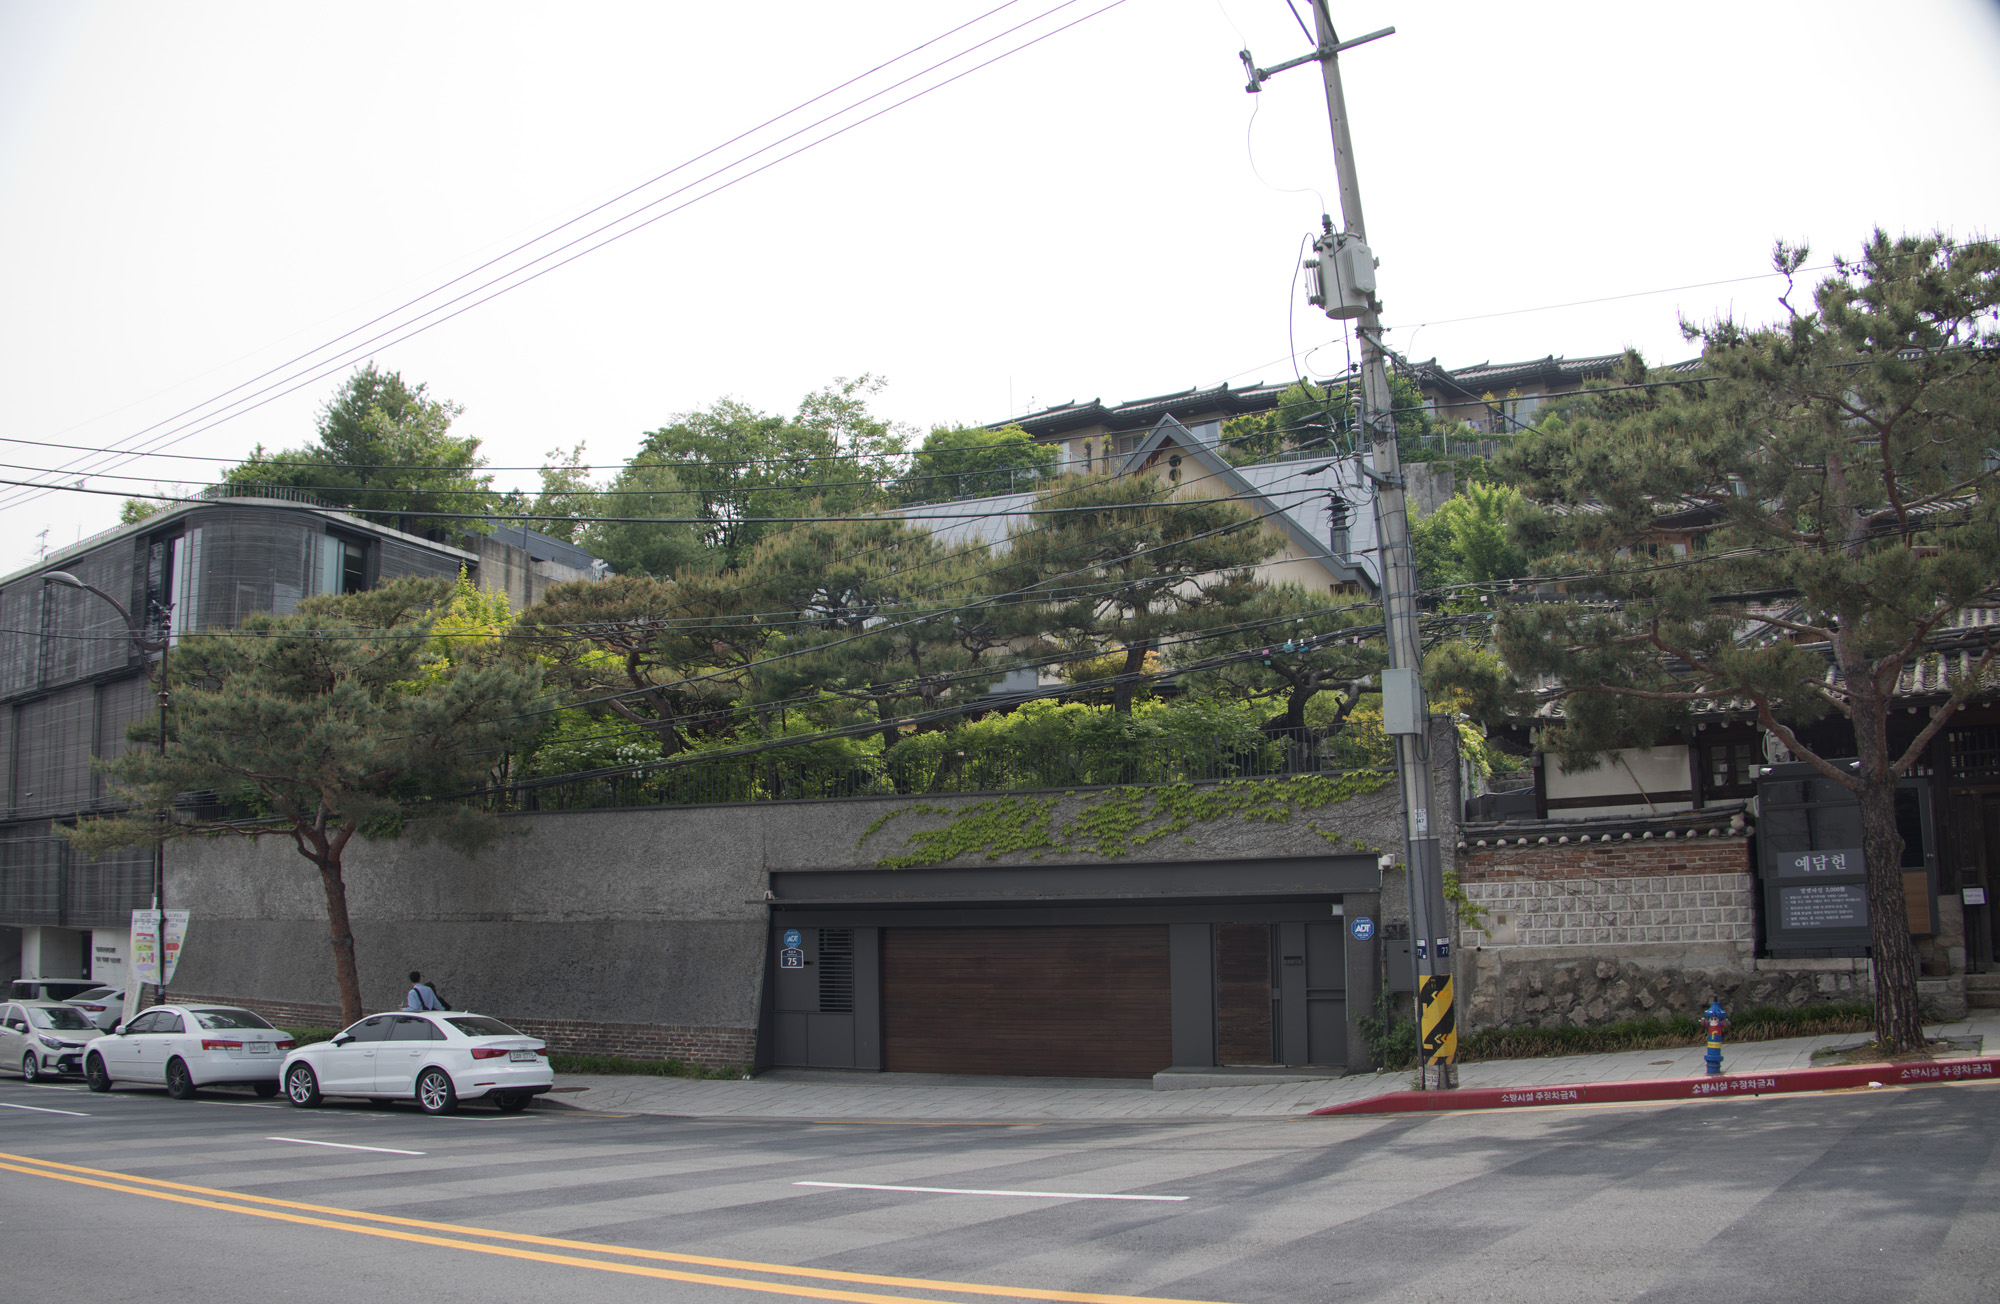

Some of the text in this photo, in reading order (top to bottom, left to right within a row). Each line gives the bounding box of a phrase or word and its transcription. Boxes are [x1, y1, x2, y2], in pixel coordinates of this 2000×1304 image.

[1795, 853, 1846, 872] 예담헌
[1355, 924, 1370, 933] ADT
[787, 935, 798, 943] ADT
[1441, 946, 1449, 955] 77
[787, 957, 797, 966] 75
[1901, 1063, 1992, 1079] 소방시설 주정차금지
[1692, 1078, 1775, 1094] 소방시설 주정차금지
[1501, 1089, 1577, 1103] 소방시설 주정차금지
